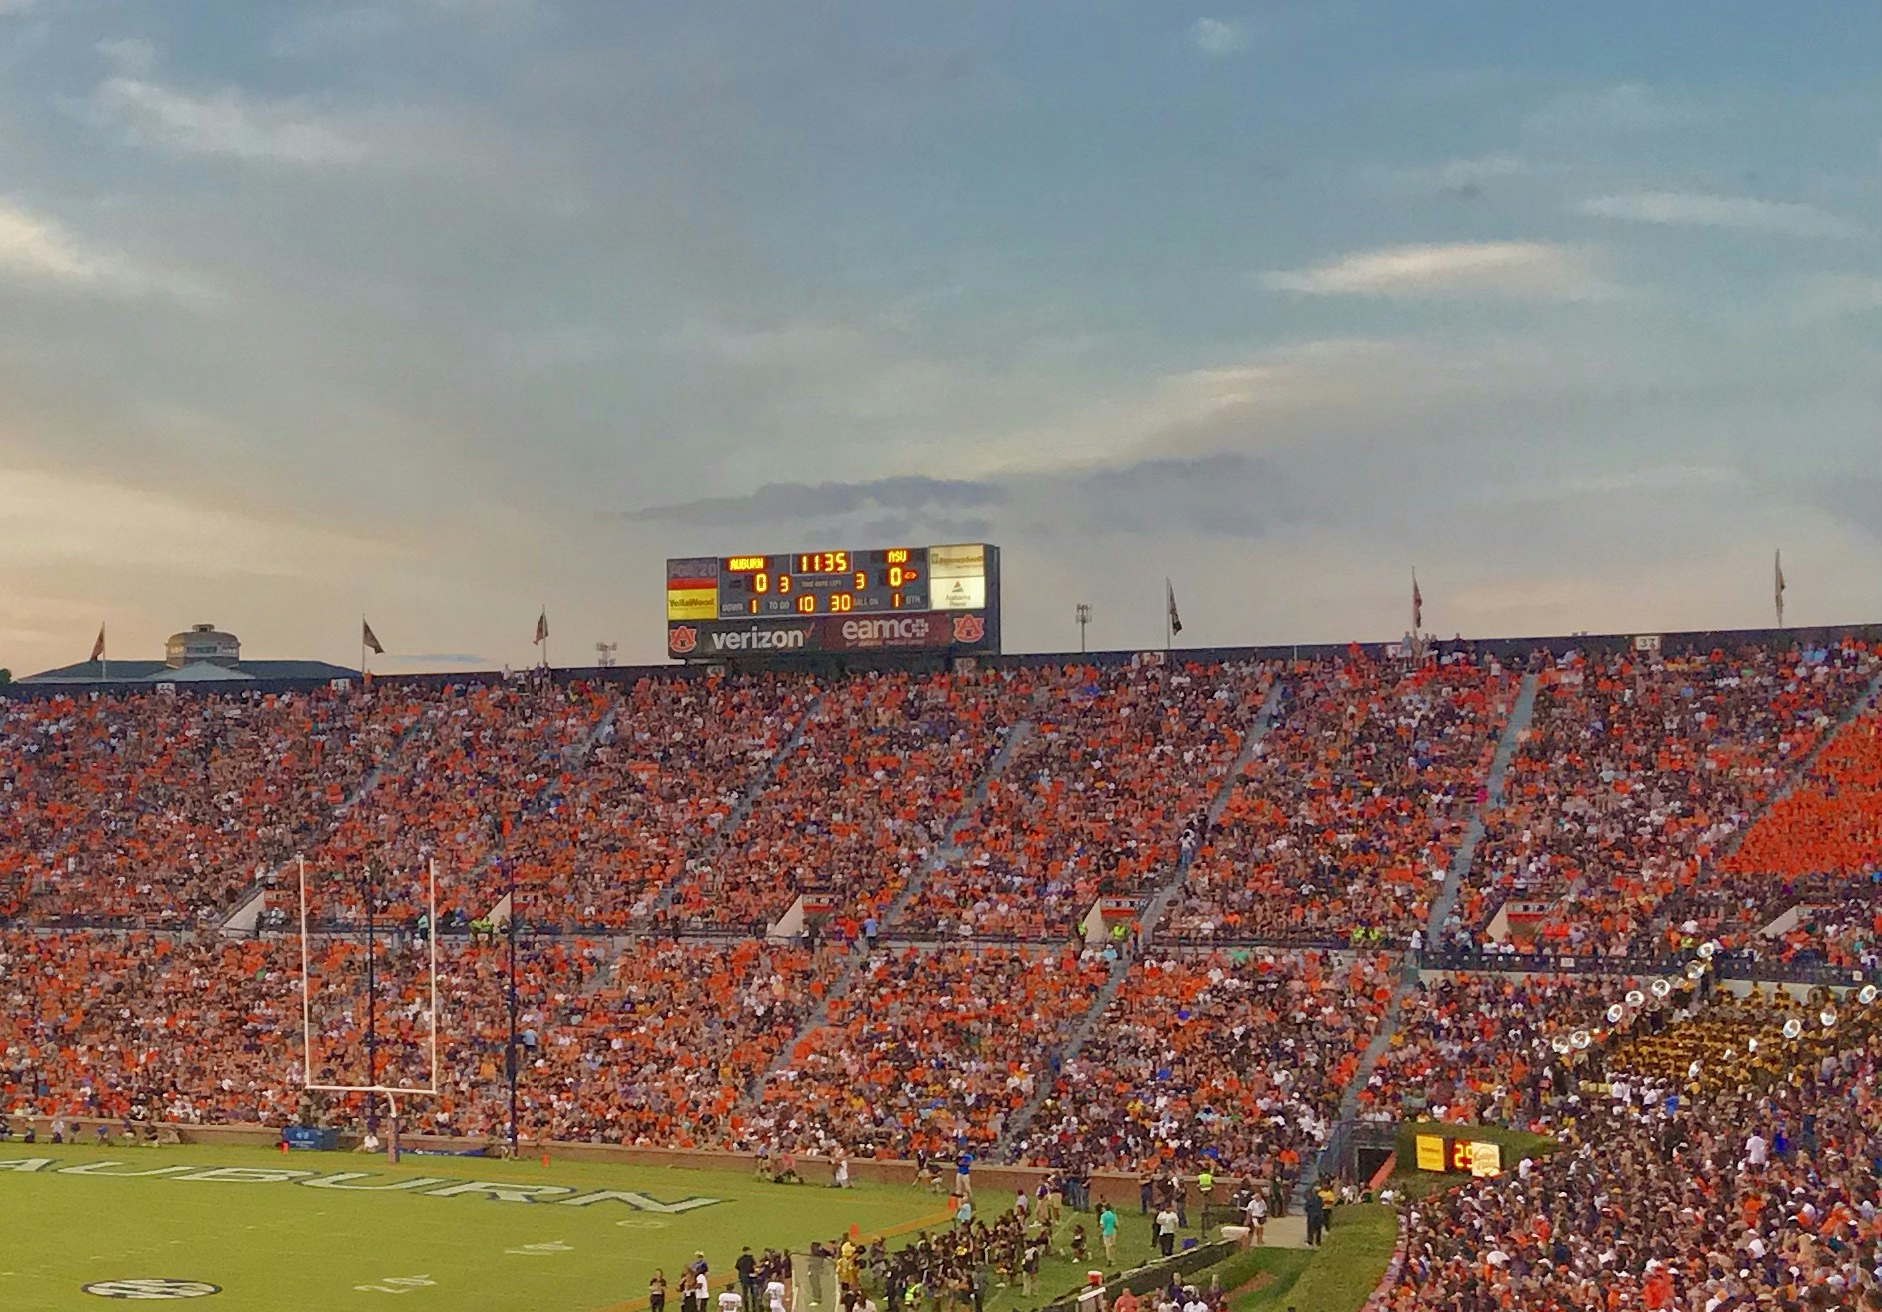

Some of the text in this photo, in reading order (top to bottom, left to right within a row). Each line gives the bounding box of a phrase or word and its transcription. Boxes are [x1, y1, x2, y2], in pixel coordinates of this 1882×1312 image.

[728, 557, 765, 572] AUBURN
[802, 552, 847, 573] 11:35
[756, 567, 902, 593] 0 3 3 0
[752, 599, 758, 614] 1
[768, 600, 778, 610] TO
[798, 595, 815, 613] 10
[830, 594, 852, 612] 30
[894, 593, 900, 608] 1
[711, 618, 914, 650] verizon eamc
